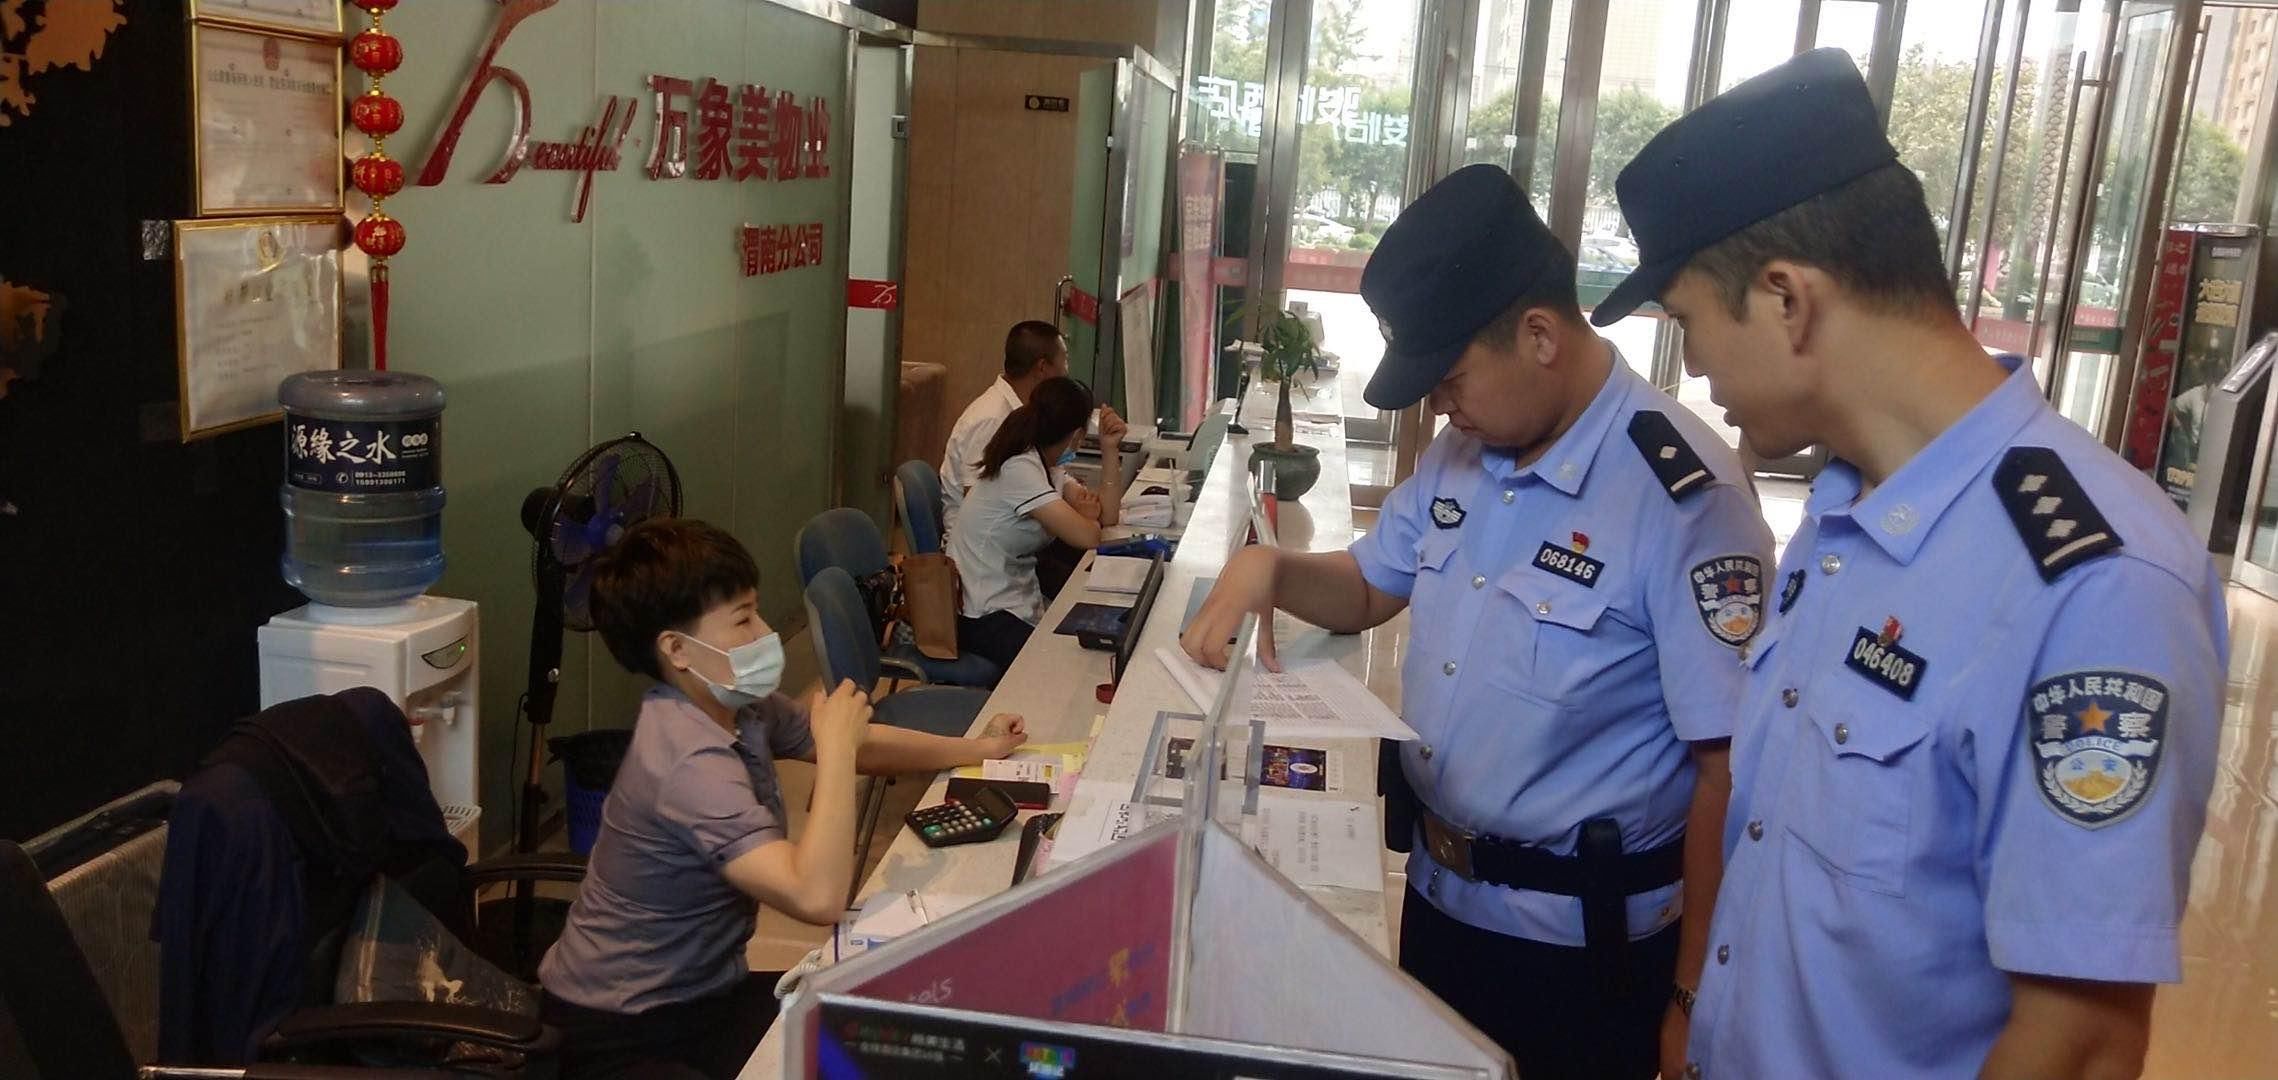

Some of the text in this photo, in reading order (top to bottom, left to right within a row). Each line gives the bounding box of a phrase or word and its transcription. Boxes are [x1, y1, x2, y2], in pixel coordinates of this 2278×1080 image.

[646, 75, 831, 181] 万象美物业
[742, 222, 823, 277] 渭南分公司
[1540, 548, 1596, 579] 068146
[1853, 637, 1915, 686] 046408
[2032, 676, 2163, 713] 中华人民共和国
